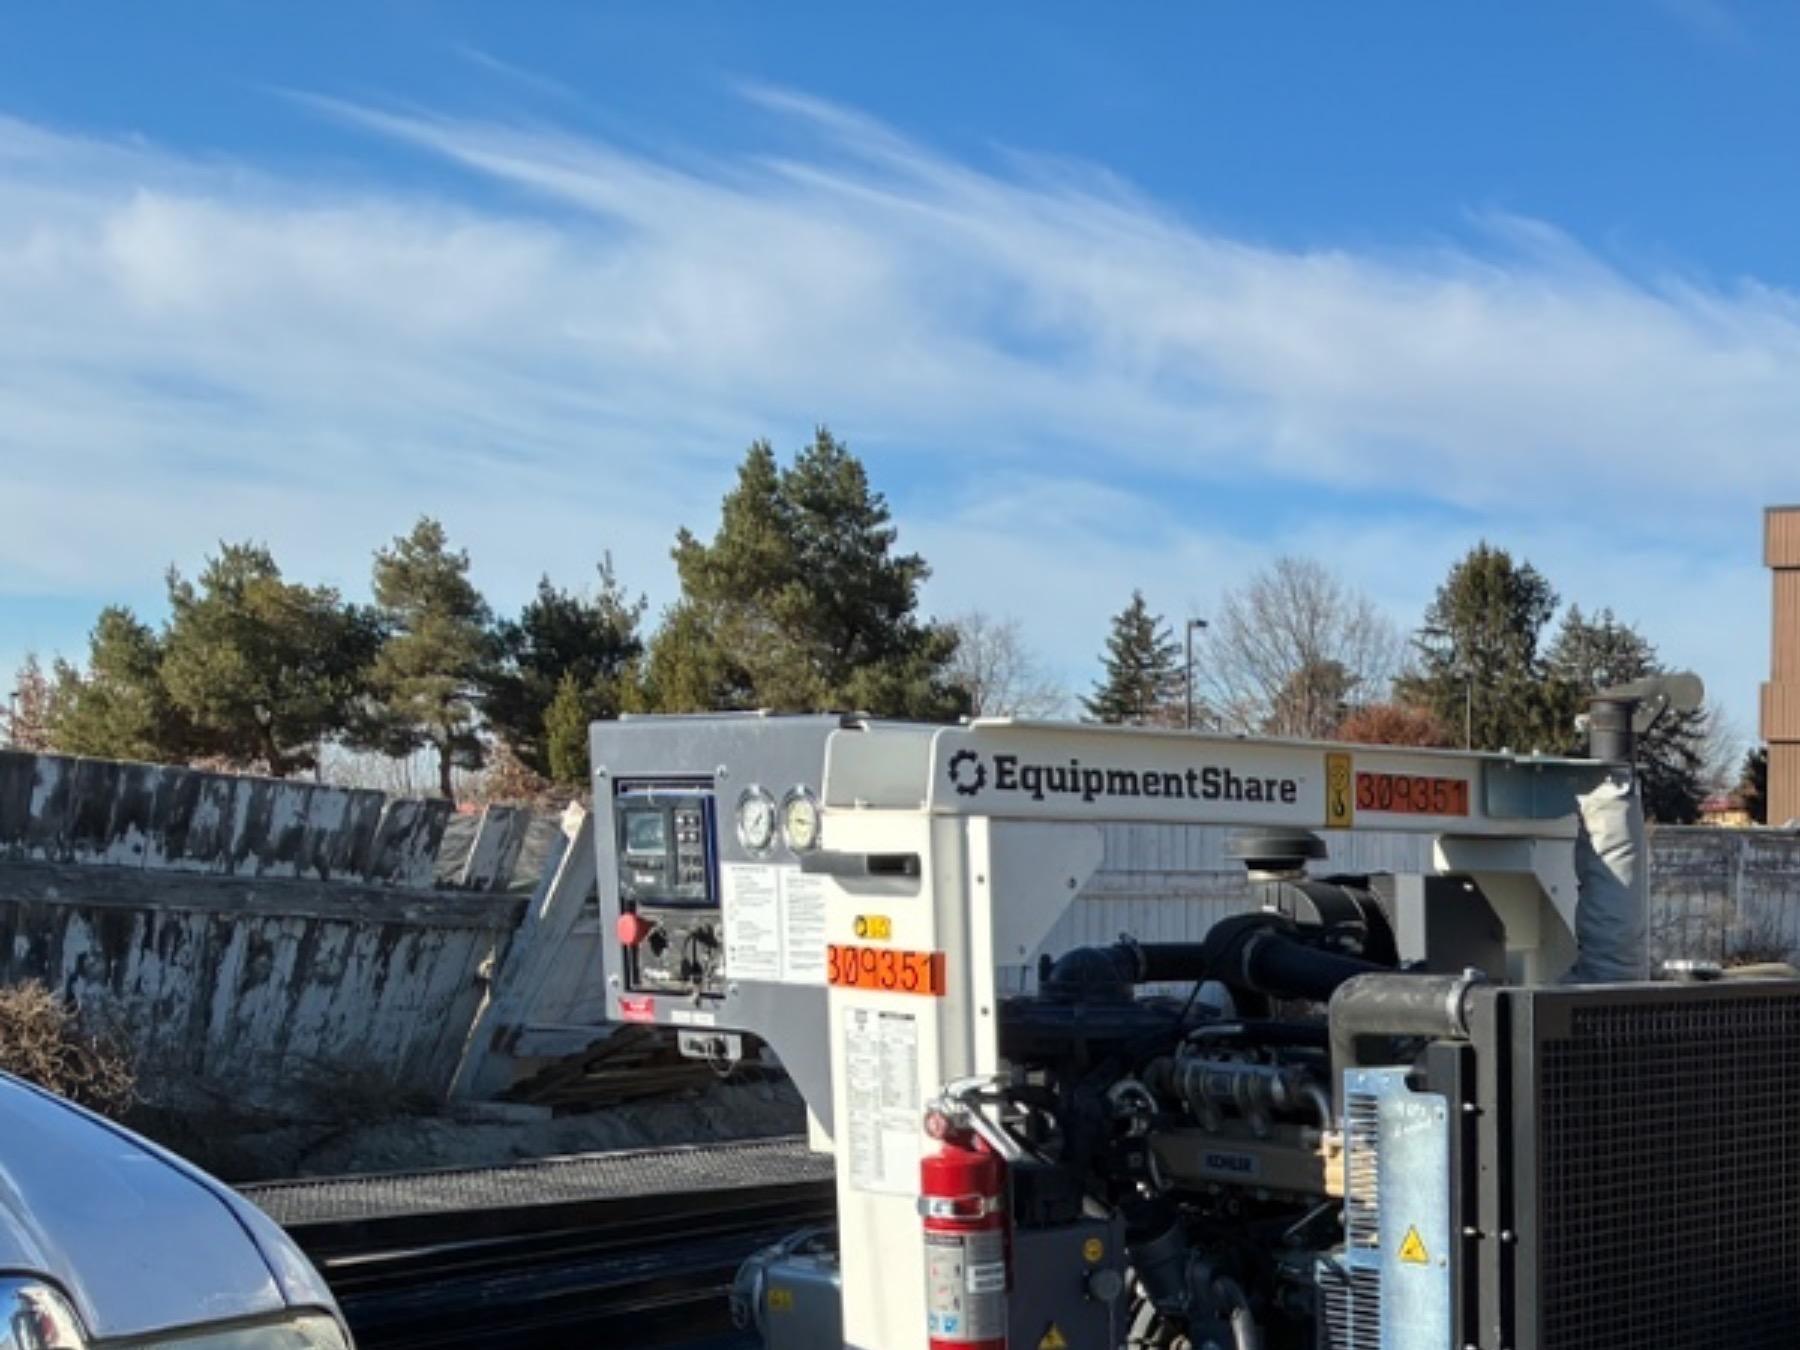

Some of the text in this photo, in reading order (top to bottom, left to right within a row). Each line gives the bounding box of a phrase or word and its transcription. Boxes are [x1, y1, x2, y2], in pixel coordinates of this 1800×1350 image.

[993, 754, 1297, 804] EquipmentShare
[1357, 773, 1467, 814] 309351
[827, 945, 938, 992] 309351
